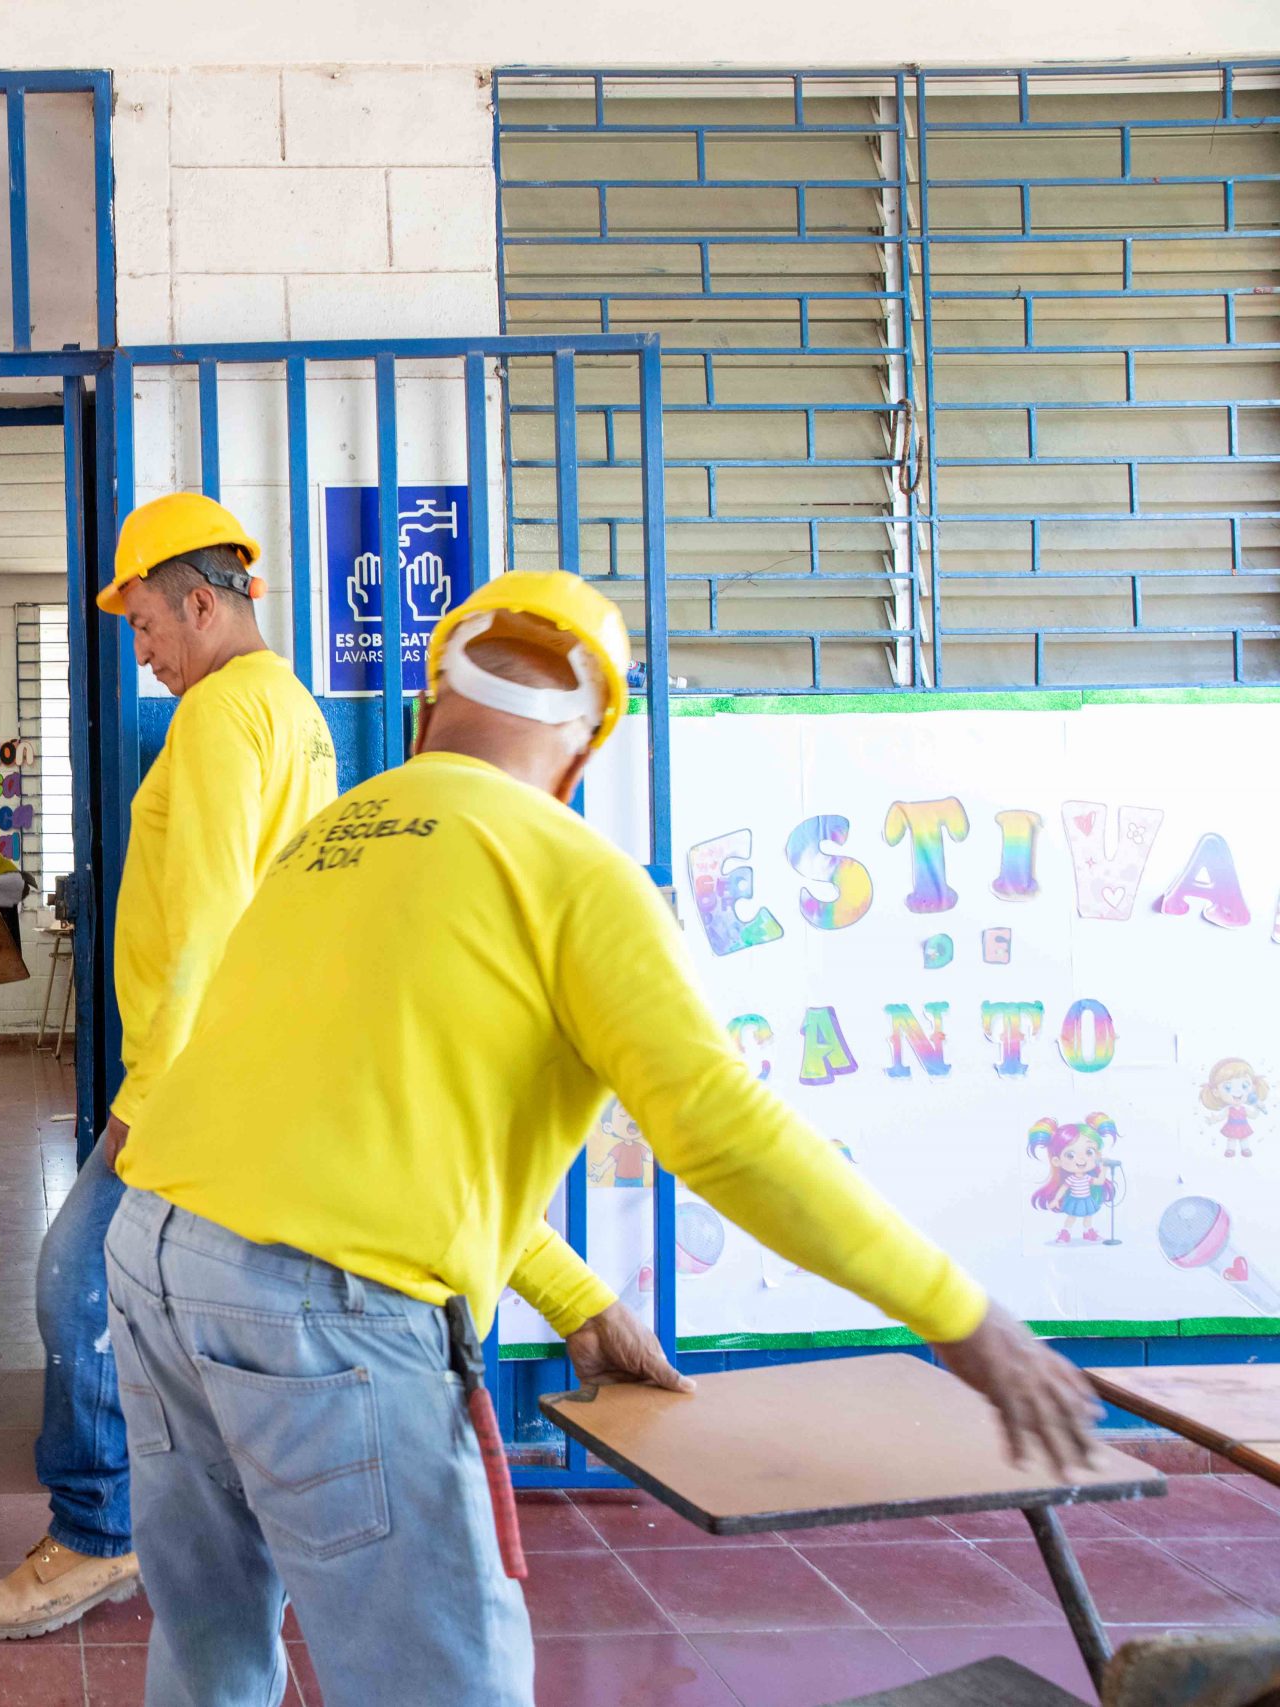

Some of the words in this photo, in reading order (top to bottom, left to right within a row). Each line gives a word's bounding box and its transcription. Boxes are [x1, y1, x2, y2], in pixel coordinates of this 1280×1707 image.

[335, 633, 355, 648] ES
[337, 799, 392, 822] DOS
[325, 817, 439, 843] ESCUELAS
[687, 796, 1280, 957] ESTIVA
[921, 927, 1013, 970] DE
[726, 998, 1120, 1086] CANTO
